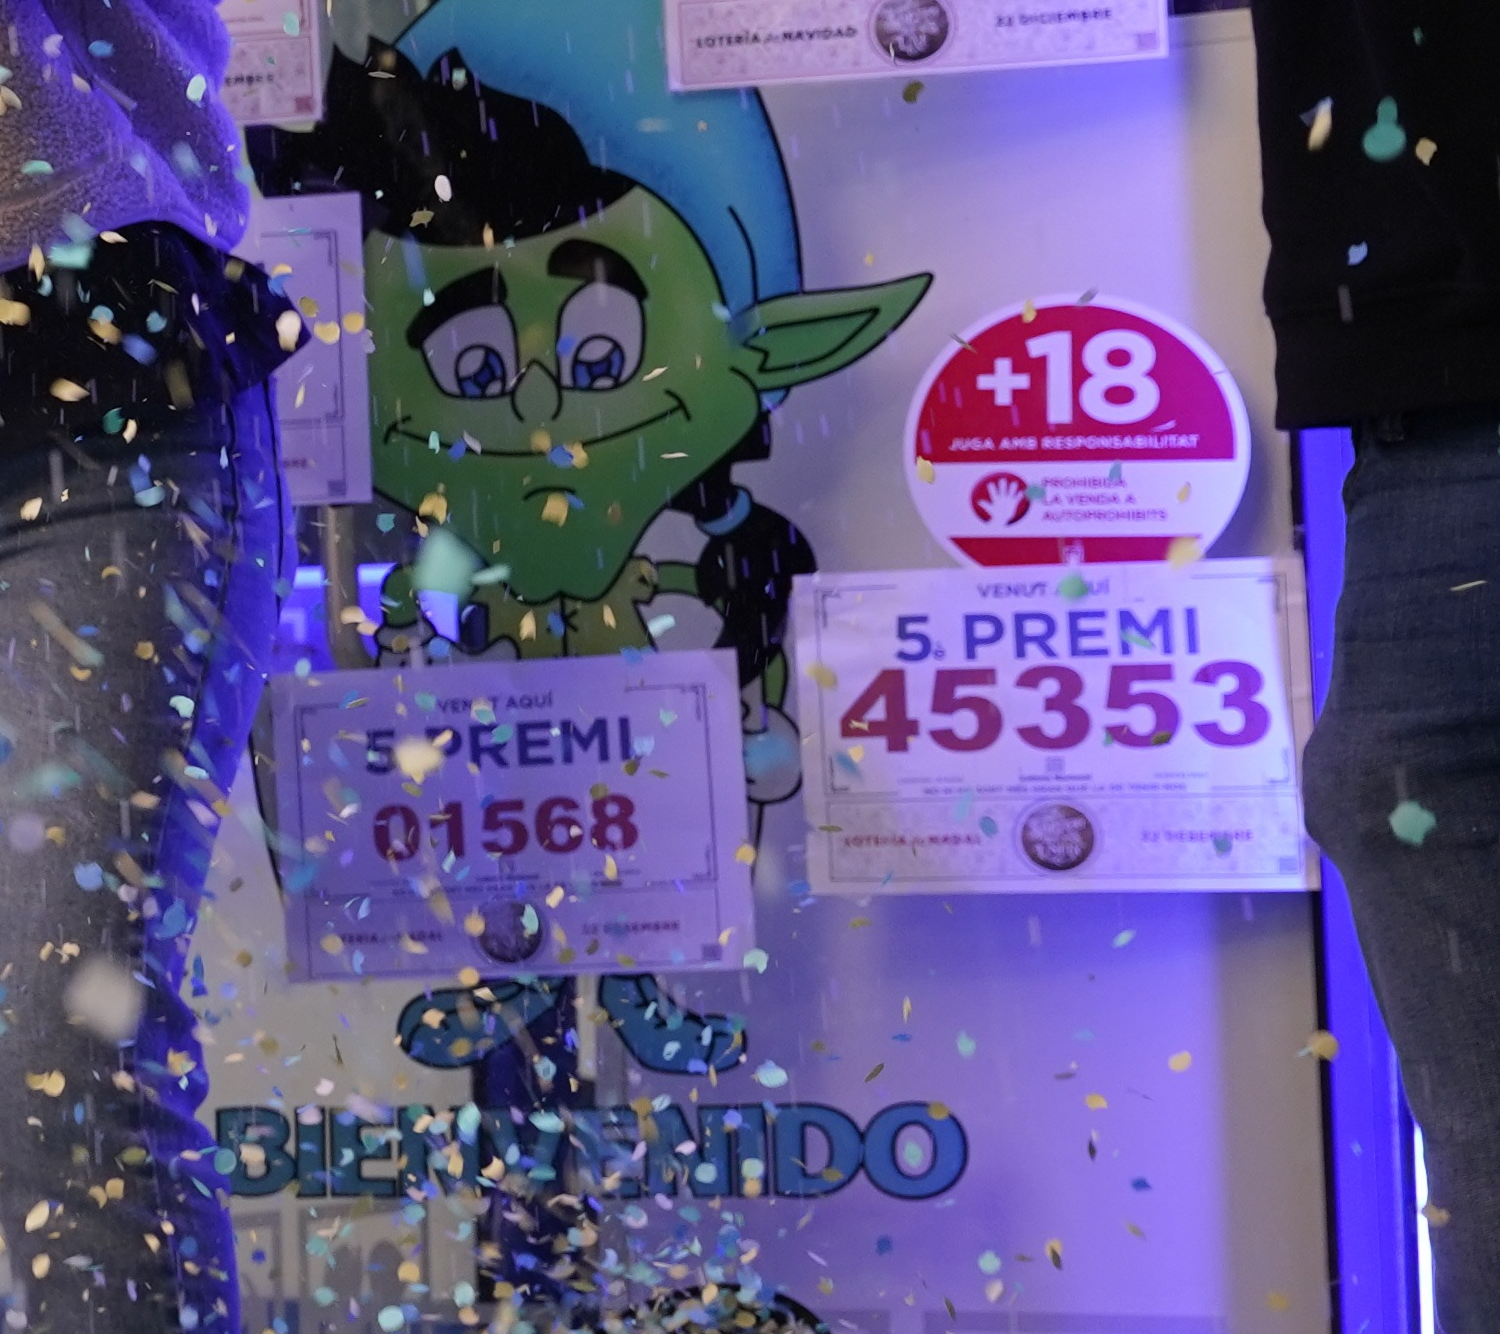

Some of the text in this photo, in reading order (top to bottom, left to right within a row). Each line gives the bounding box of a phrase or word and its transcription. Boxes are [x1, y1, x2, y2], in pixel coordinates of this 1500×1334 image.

[696, 30, 761, 51] LOTERÍA
[781, 24, 859, 44] NAVIDAD
[975, 328, 1162, 425] +18
[949, 433, 1201, 452] JUGA AMB RESPONSABILITAT
[976, 581, 1049, 601] VENUT
[963, 606, 1200, 662] PREMI
[437, 690, 553, 713] VENT AQUÍ
[839, 659, 1272, 755] 45353
[424, 716, 634, 769] PREMI
[372, 794, 641, 861] 01568
[213, 1100, 970, 1202] BIENVENIDO
